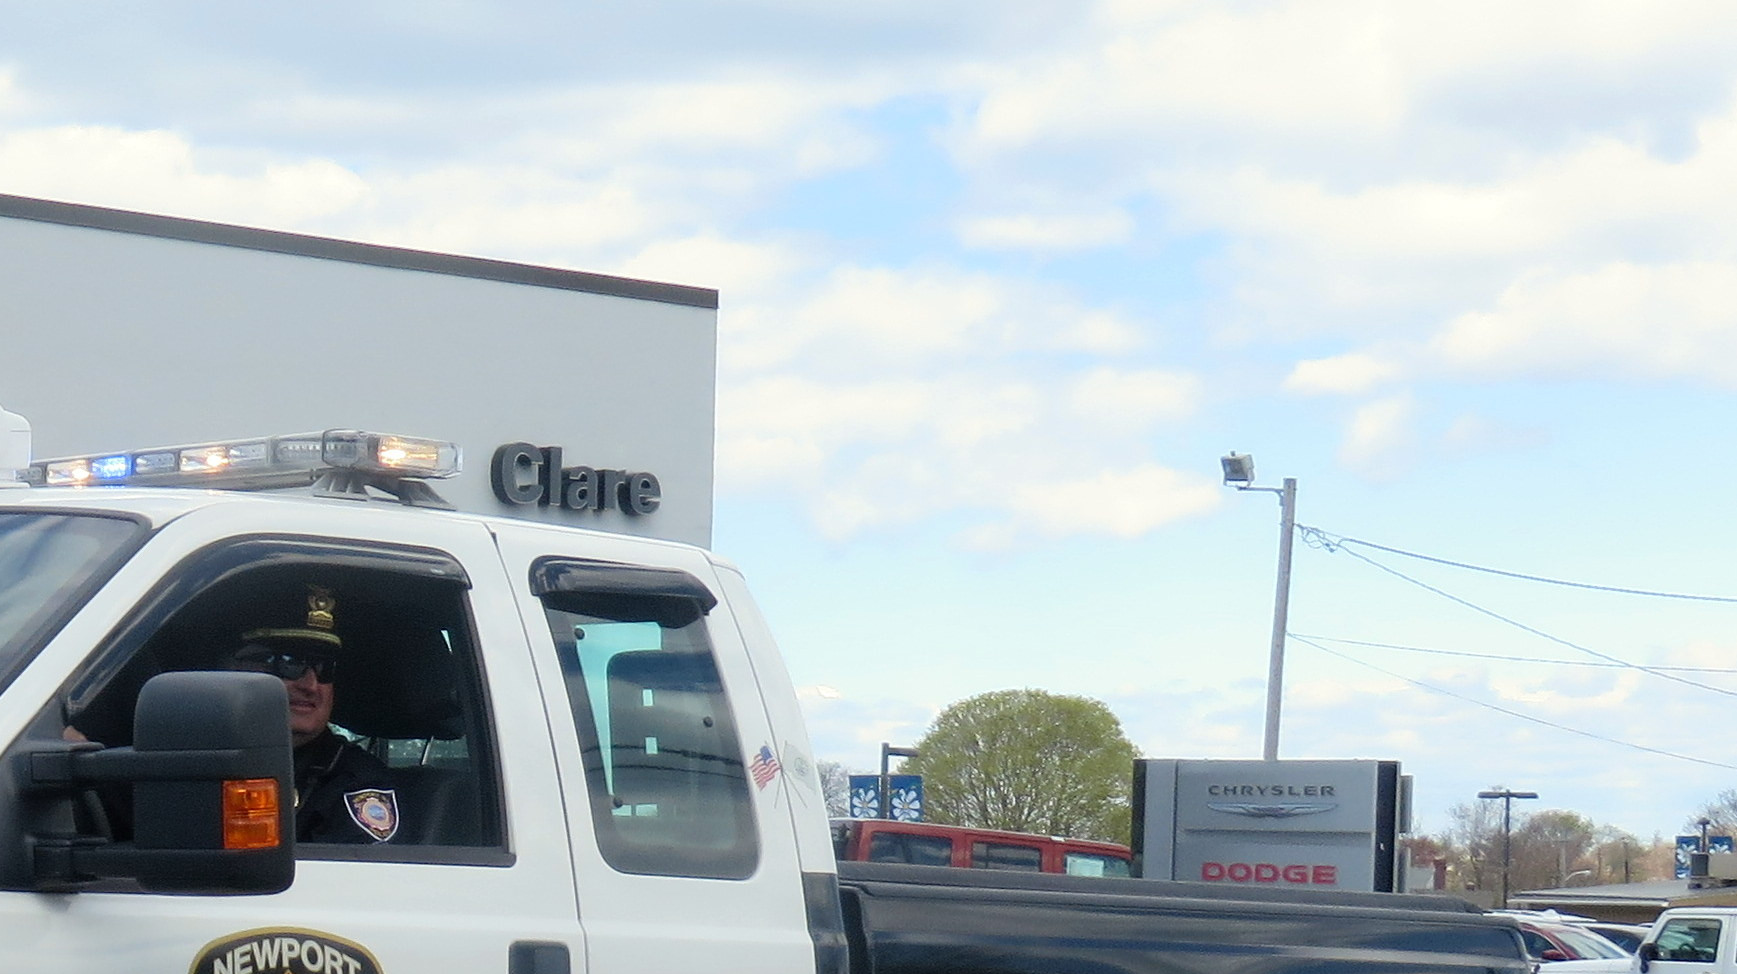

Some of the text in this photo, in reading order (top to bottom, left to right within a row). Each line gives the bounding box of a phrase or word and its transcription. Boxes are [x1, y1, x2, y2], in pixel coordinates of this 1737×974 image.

[490, 442, 662, 515] Clare
[1208, 785, 1336, 797] CHRYSLER
[1202, 862, 1337, 884] DODGE
